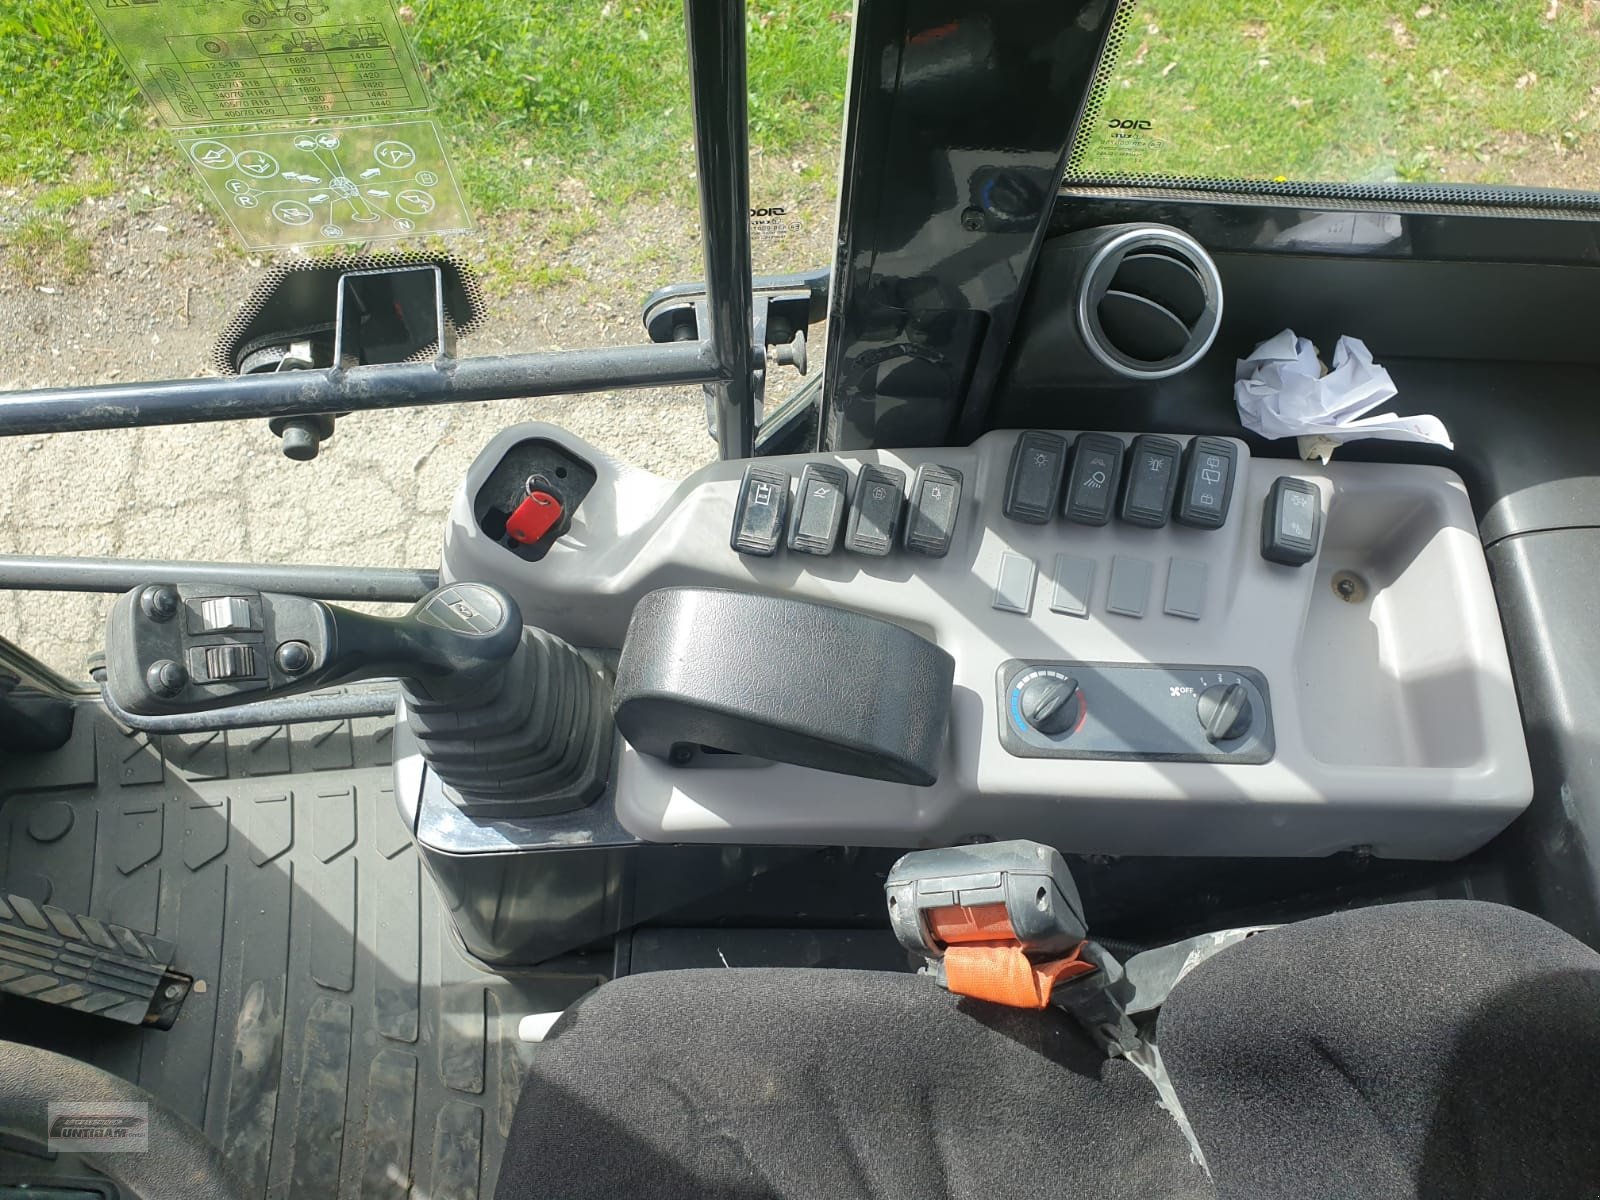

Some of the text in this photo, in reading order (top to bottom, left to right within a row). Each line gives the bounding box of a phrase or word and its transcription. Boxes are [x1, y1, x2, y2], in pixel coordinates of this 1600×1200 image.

[230, 182, 241, 192] F
[239, 196, 254, 206] R
[398, 220, 411, 230] N
[1180, 687, 1195, 695] OFF
